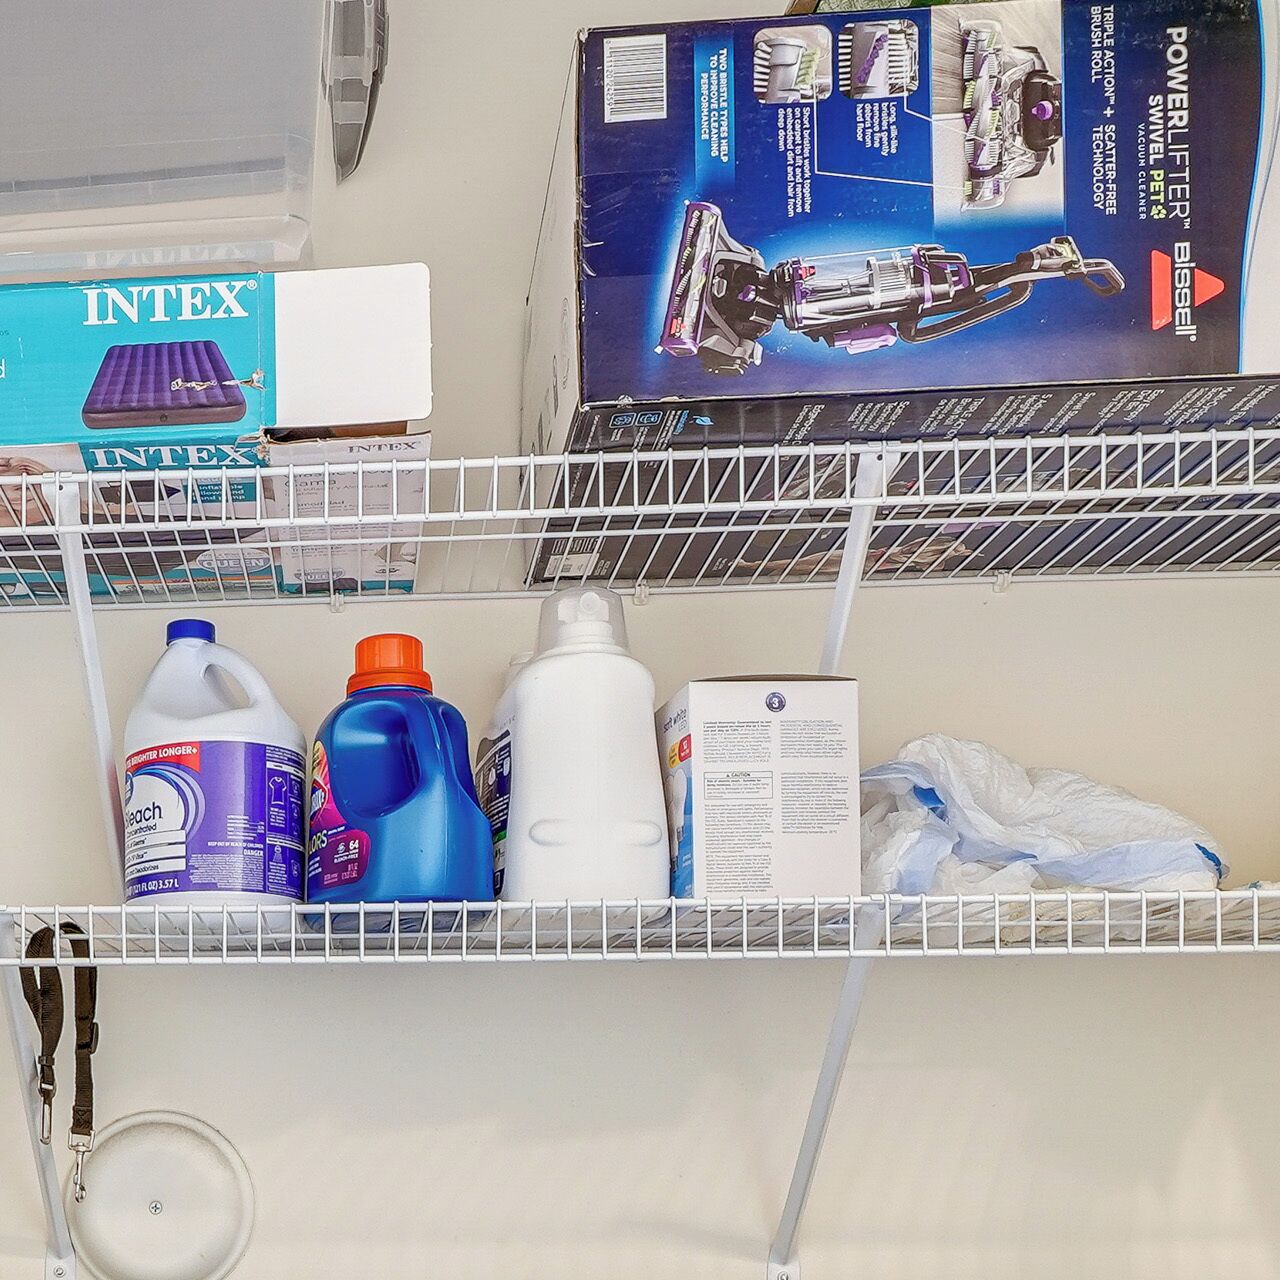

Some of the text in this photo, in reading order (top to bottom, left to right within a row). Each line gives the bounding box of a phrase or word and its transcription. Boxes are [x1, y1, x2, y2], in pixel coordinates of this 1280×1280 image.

[1102, 5, 1115, 47] TRIPLE
[701, 73, 709, 140] PERFORMANCE
[710, 55, 719, 156] TO IMPROVE CLEANING
[719, 48, 728, 162] TWO BRISTLE TYPES HELP
[777, 108, 785, 128] deep
[795, 108, 801, 117] on
[1091, 7, 1104, 210] BRUSH ROLL TECHNOLOGY
[786, 108, 794, 149] embedded
[794, 119, 802, 145] carpet
[856, 104, 864, 141] hard floor
[880, 102, 889, 156] bristles gently
[890, 125, 898, 153] silk-like
[795, 146, 802, 154] to
[1148, 95, 1164, 203] SWIVEL PET
[1104, 124, 1116, 215] SCATTER-FREE
[803, 180, 811, 212] together
[772, 697, 779, 708] 3
[132, 753, 157, 764] BRIGHTER
[349, 840, 359, 849] 64
[158, 879, 173, 889] 3.57
[175, 878, 179, 887] L
